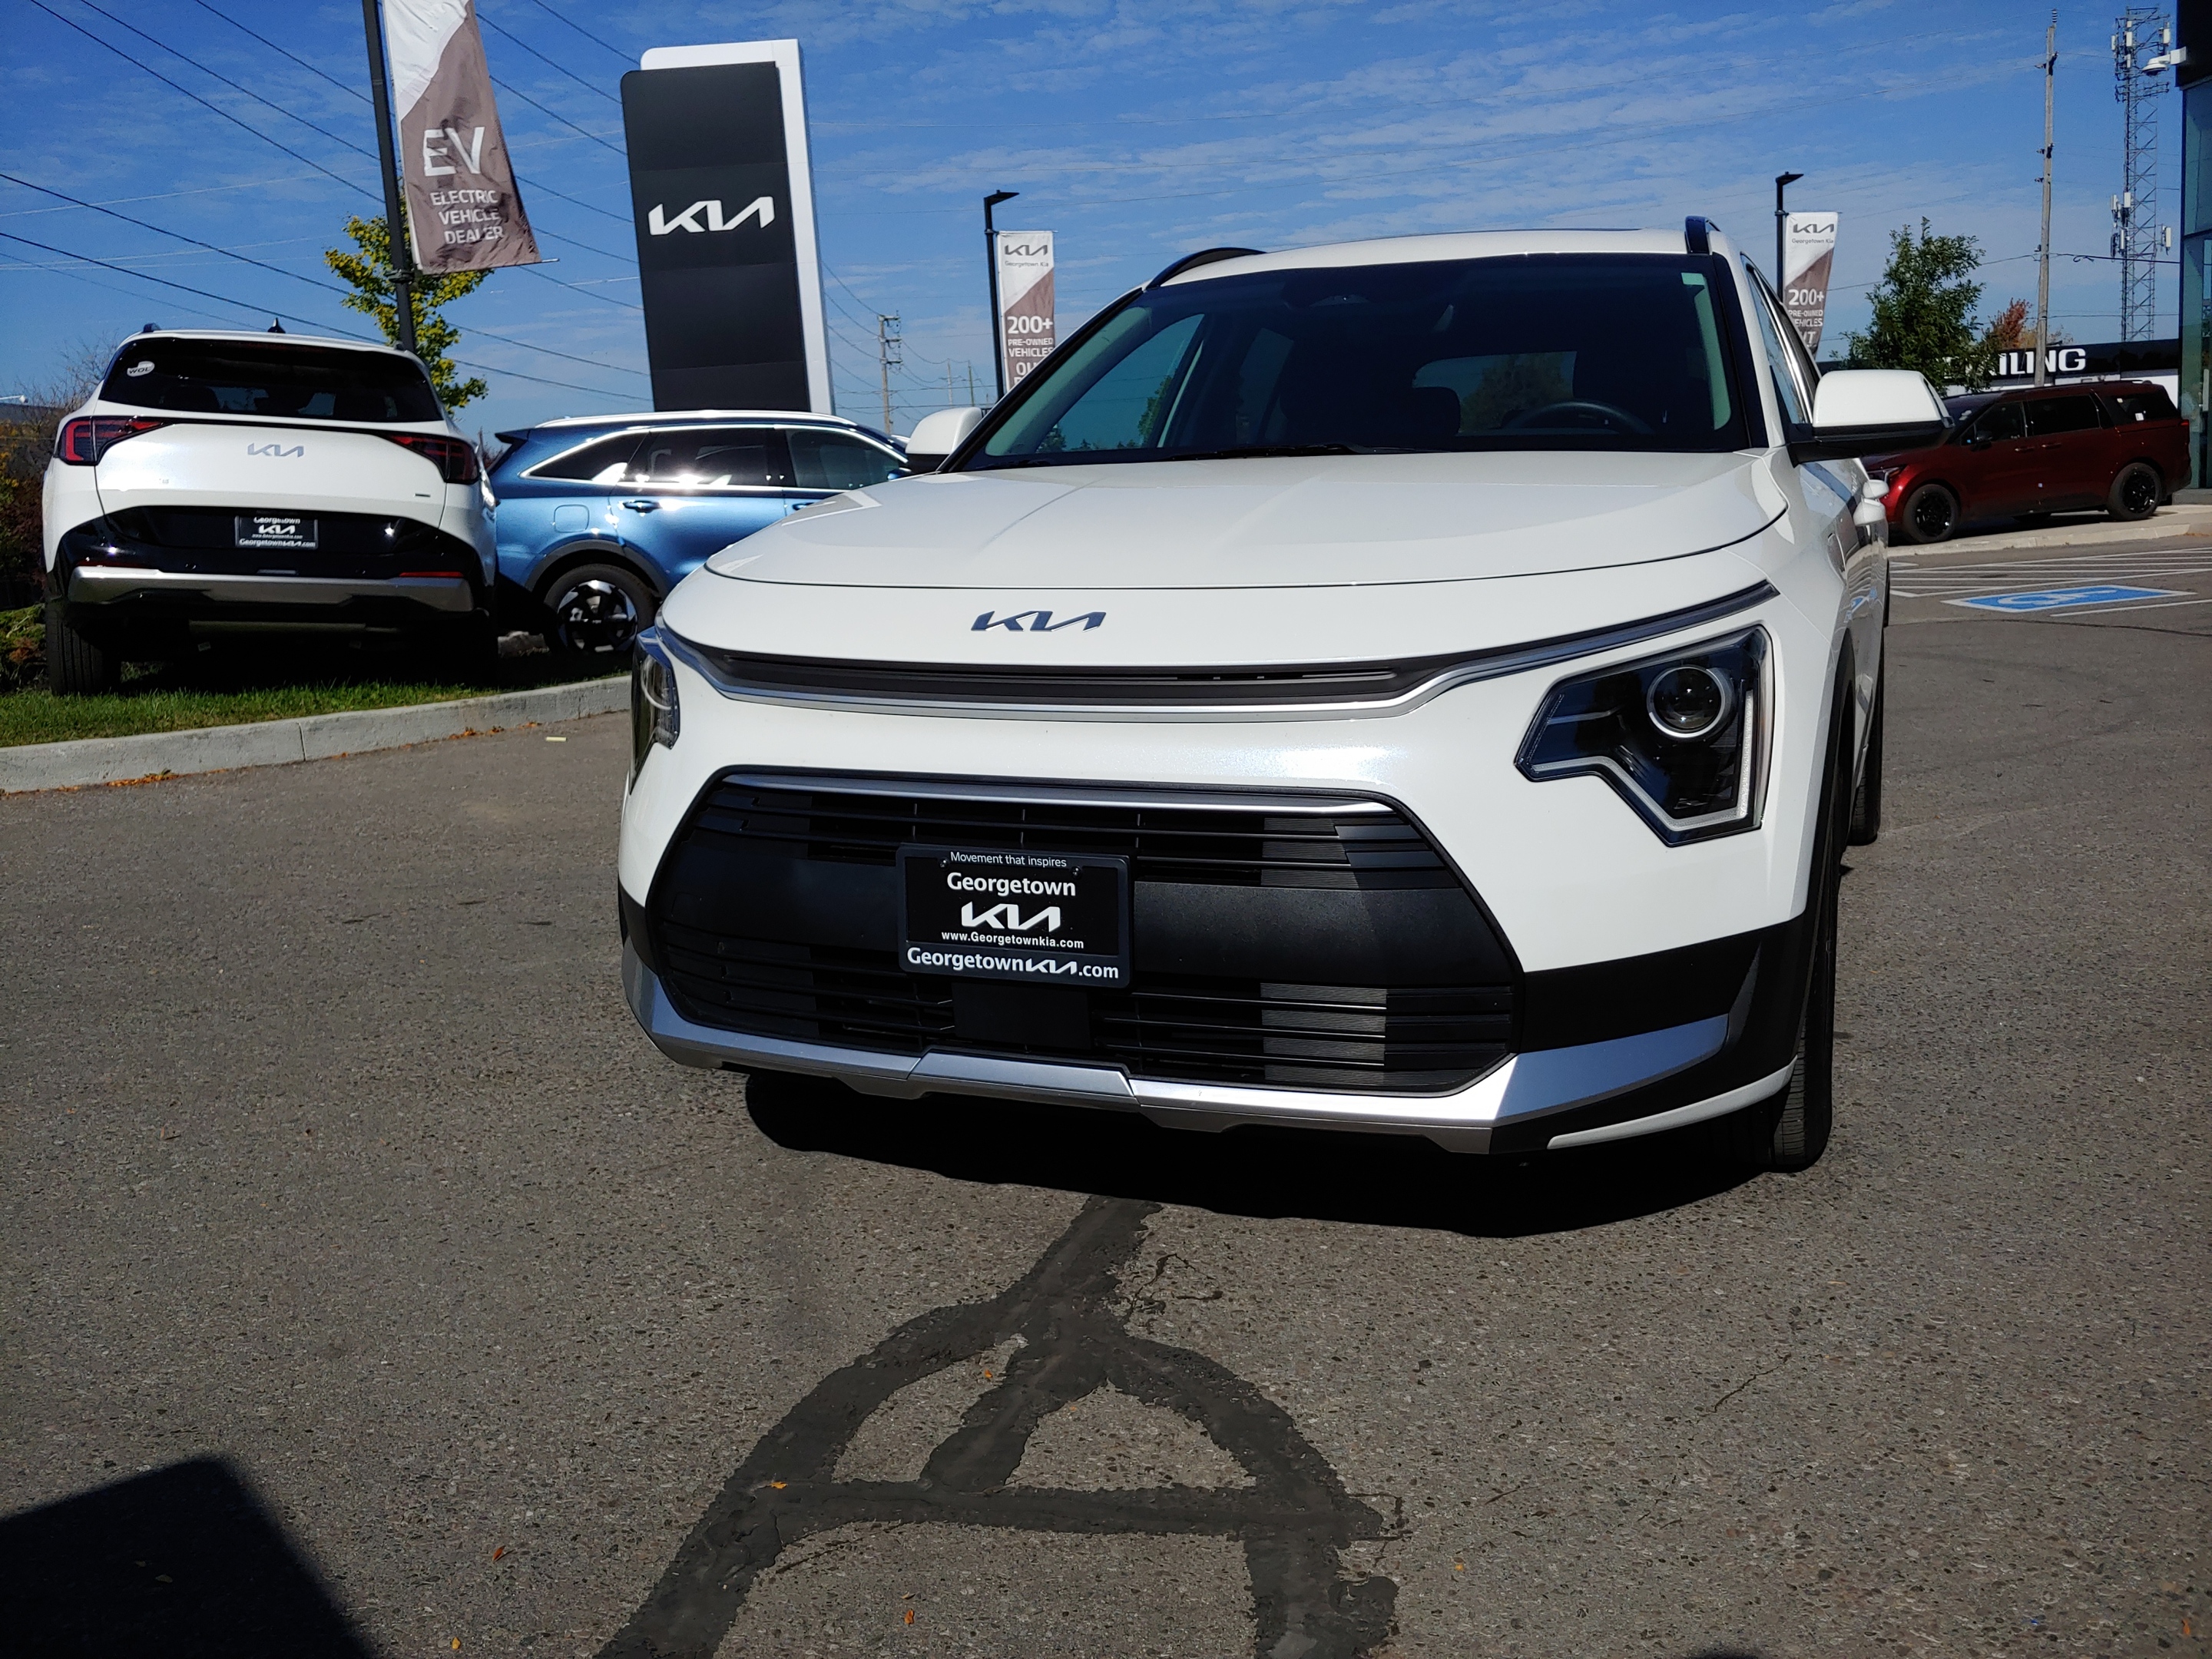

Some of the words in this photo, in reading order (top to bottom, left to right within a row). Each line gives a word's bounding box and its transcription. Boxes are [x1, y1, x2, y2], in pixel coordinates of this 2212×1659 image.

[423, 127, 485, 177] EV
[430, 190, 498, 206] ELECTRIC
[439, 208, 501, 225] VEHICLE
[648, 196, 775, 236] KIA
[1793, 224, 1834, 233] KIA
[1005, 244, 1048, 256] KIA
[1788, 289, 1824, 306] 200+
[1007, 316, 1053, 334] 200+
[1794, 318, 1823, 326] EHICLES
[1008, 347, 1053, 357] VEHICLES
[247, 442, 304, 458] KIA
[258, 525, 296, 535] KIA
[971, 611, 1107, 632] KIA
[950, 851, 1003, 864] Movement
[1005, 854, 1025, 866] that
[1028, 856, 1067, 868] inspires
[947, 872, 1076, 896] Georgetown
[961, 901, 1061, 932] KIA
[941, 931, 1084, 949] www.Georgetownkia.com
